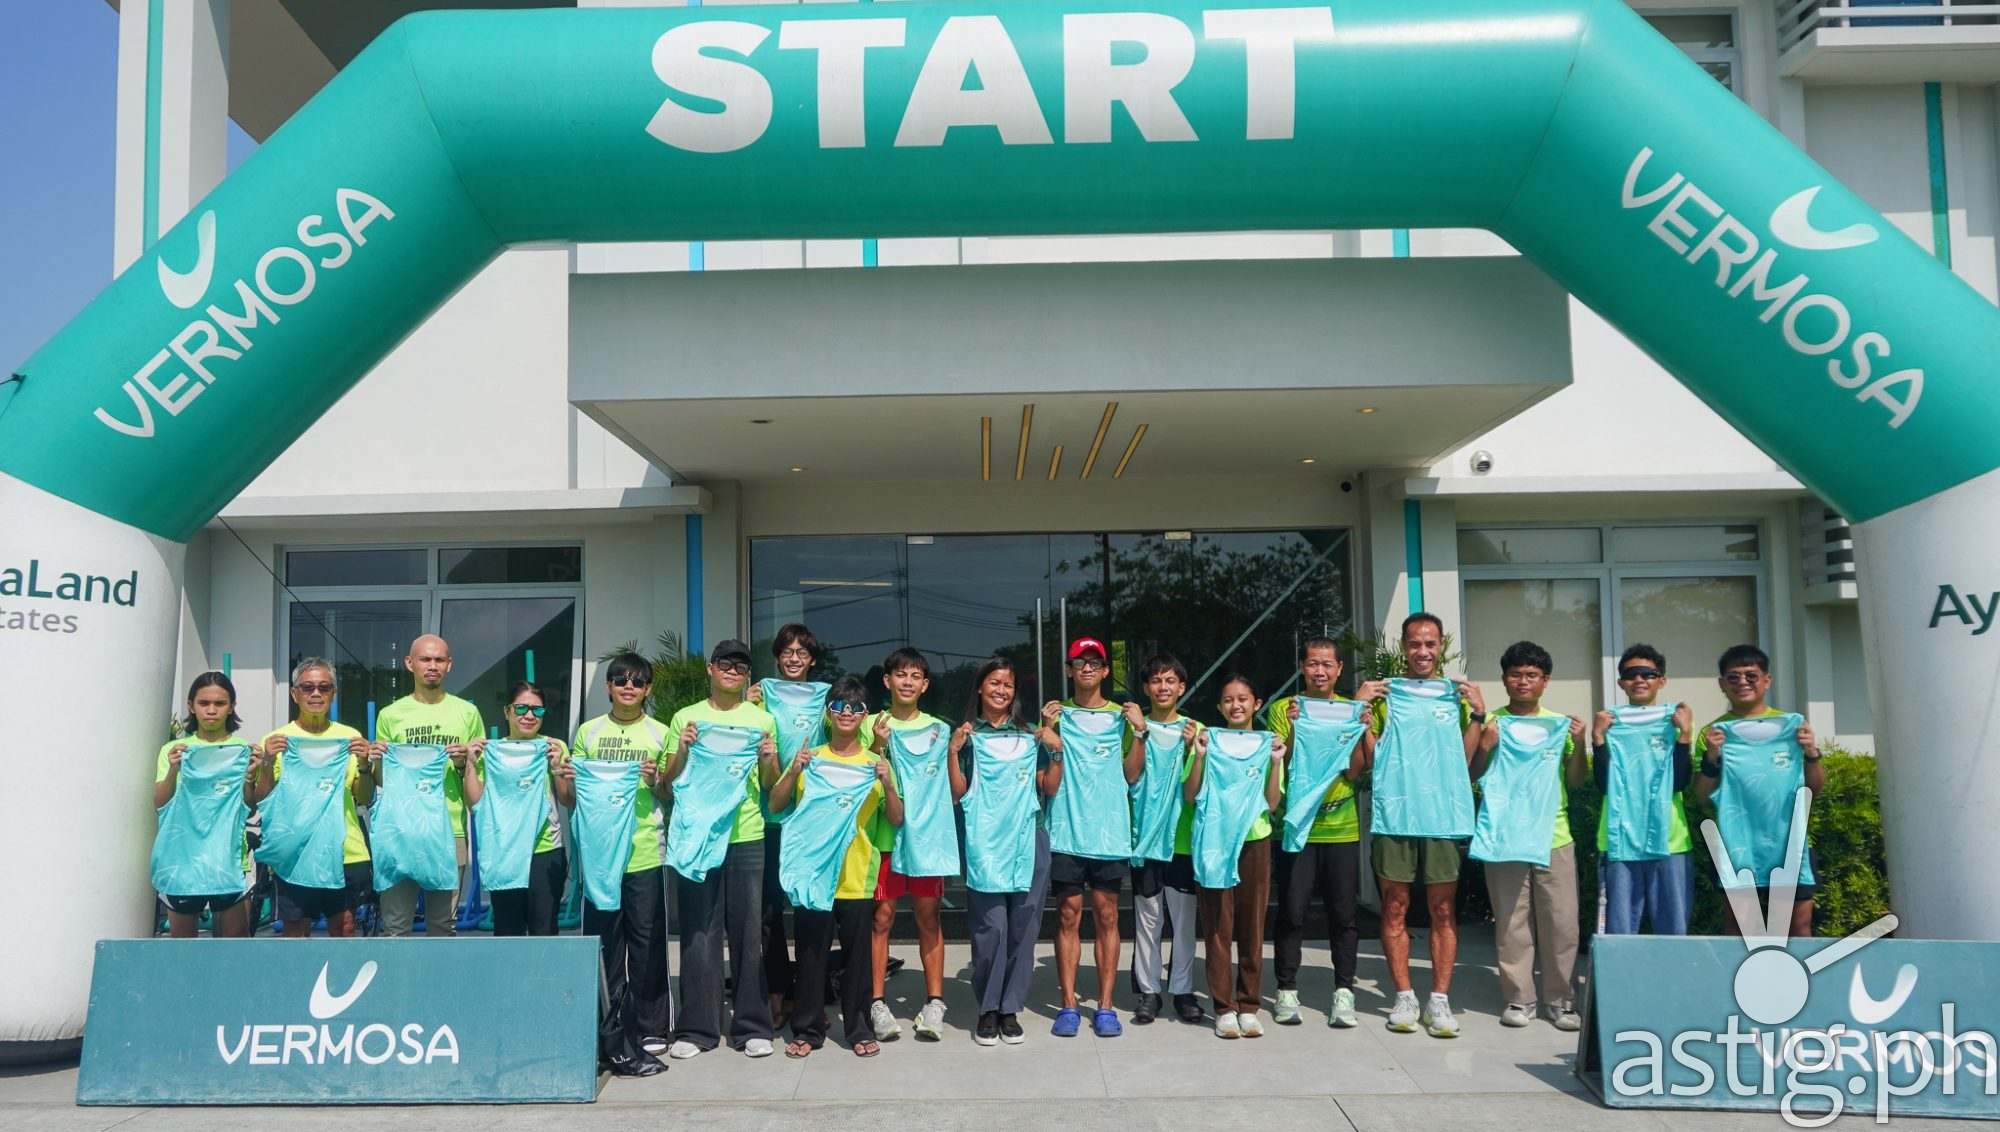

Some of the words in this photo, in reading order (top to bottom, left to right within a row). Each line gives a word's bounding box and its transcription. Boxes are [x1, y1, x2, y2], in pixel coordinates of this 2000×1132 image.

[645, 6, 1334, 153] START
[93, 187, 397, 439] VERMOSA
[1620, 146, 1925, 430] VERMOSA
[1928, 583, 2000, 636] Ay
[405, 725, 433, 737] TAKBO
[598, 736, 623, 748] TAKBO
[216, 1022, 459, 1065] VERMOSA
